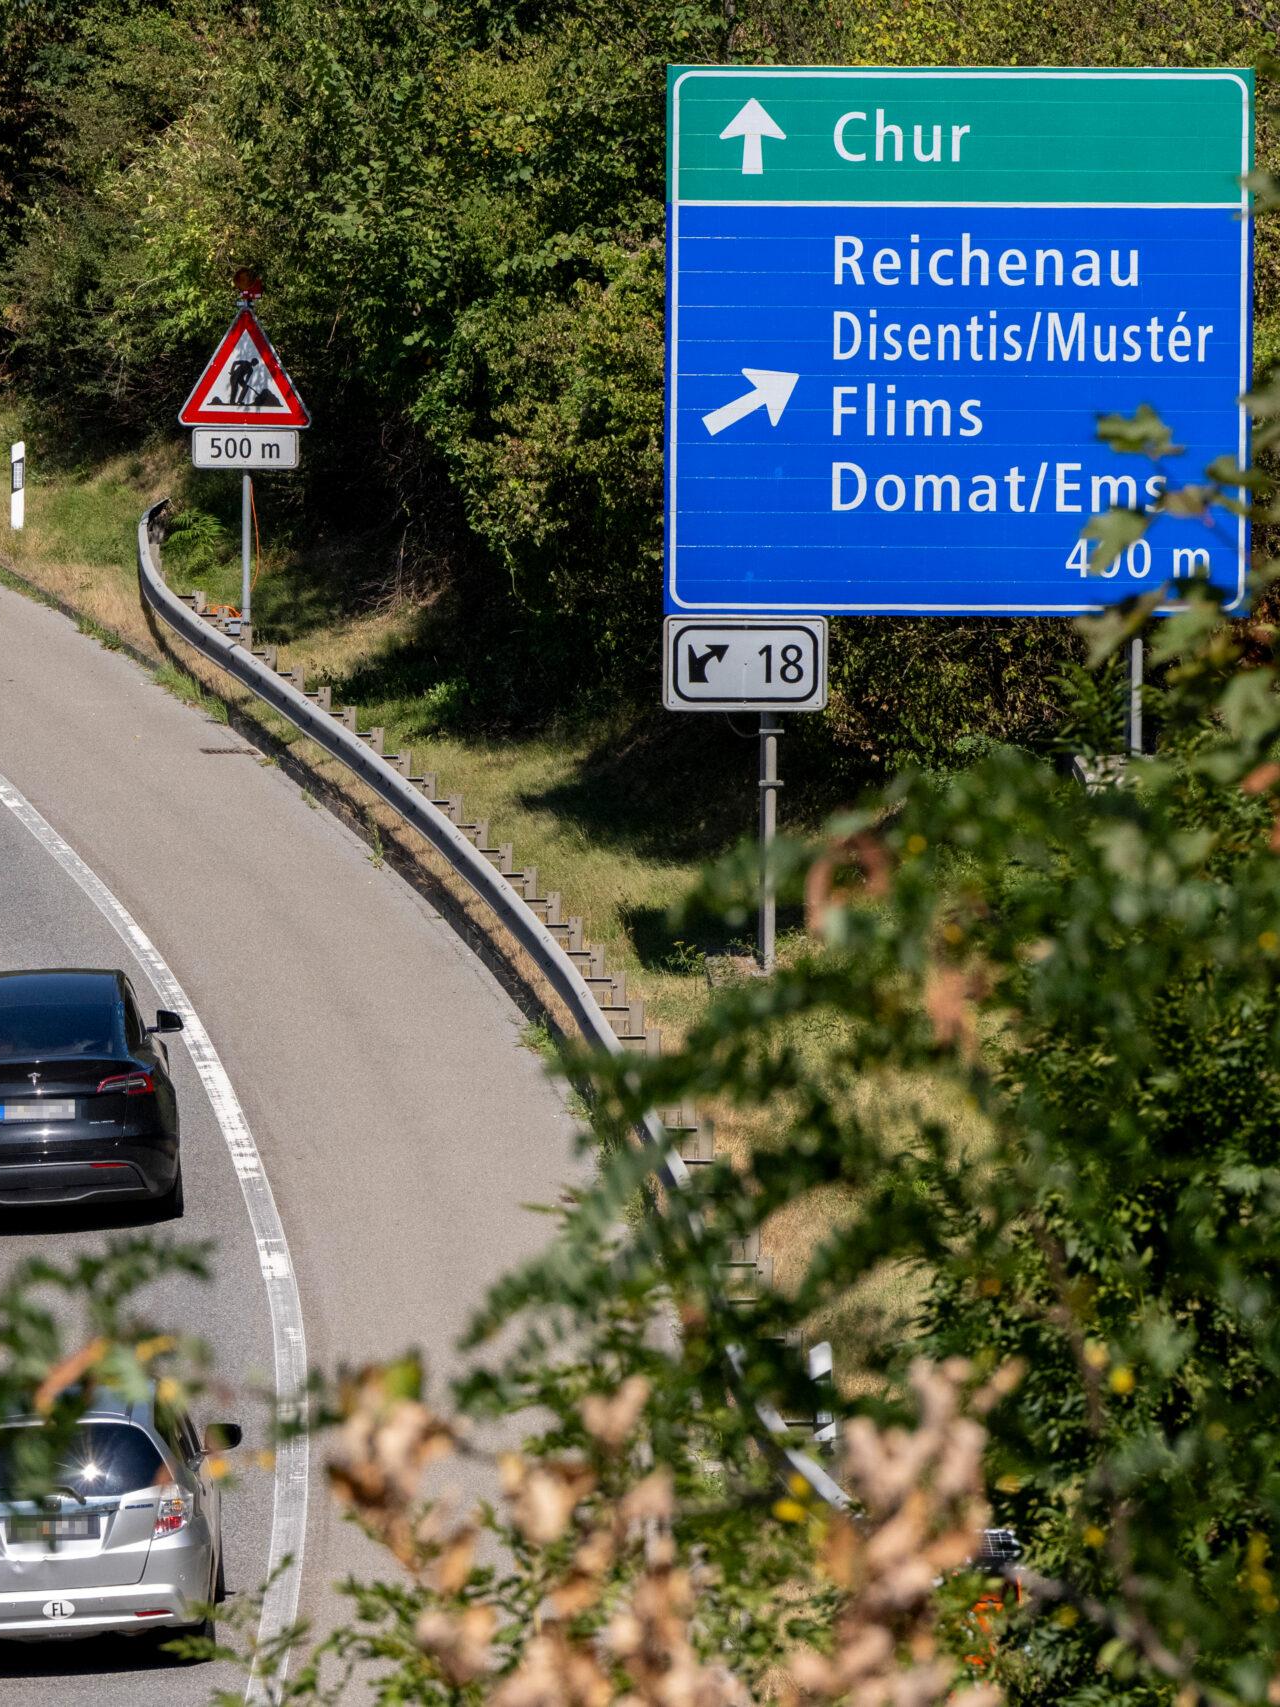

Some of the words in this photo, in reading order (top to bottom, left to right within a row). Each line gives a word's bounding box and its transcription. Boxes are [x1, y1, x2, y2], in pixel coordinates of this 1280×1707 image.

[833, 108, 971, 162] Chur
[833, 232, 1140, 287] Reichenau
[832, 309, 1214, 363] Disentis/Mustér
[832, 383, 984, 437] Flims
[210, 437, 252, 459] 500
[261, 443, 280, 459] m
[831, 461, 1167, 513] Domat/Ems
[1173, 548, 1210, 578] m
[758, 644, 805, 684] 18
[52, 1602, 68, 1617] FL
